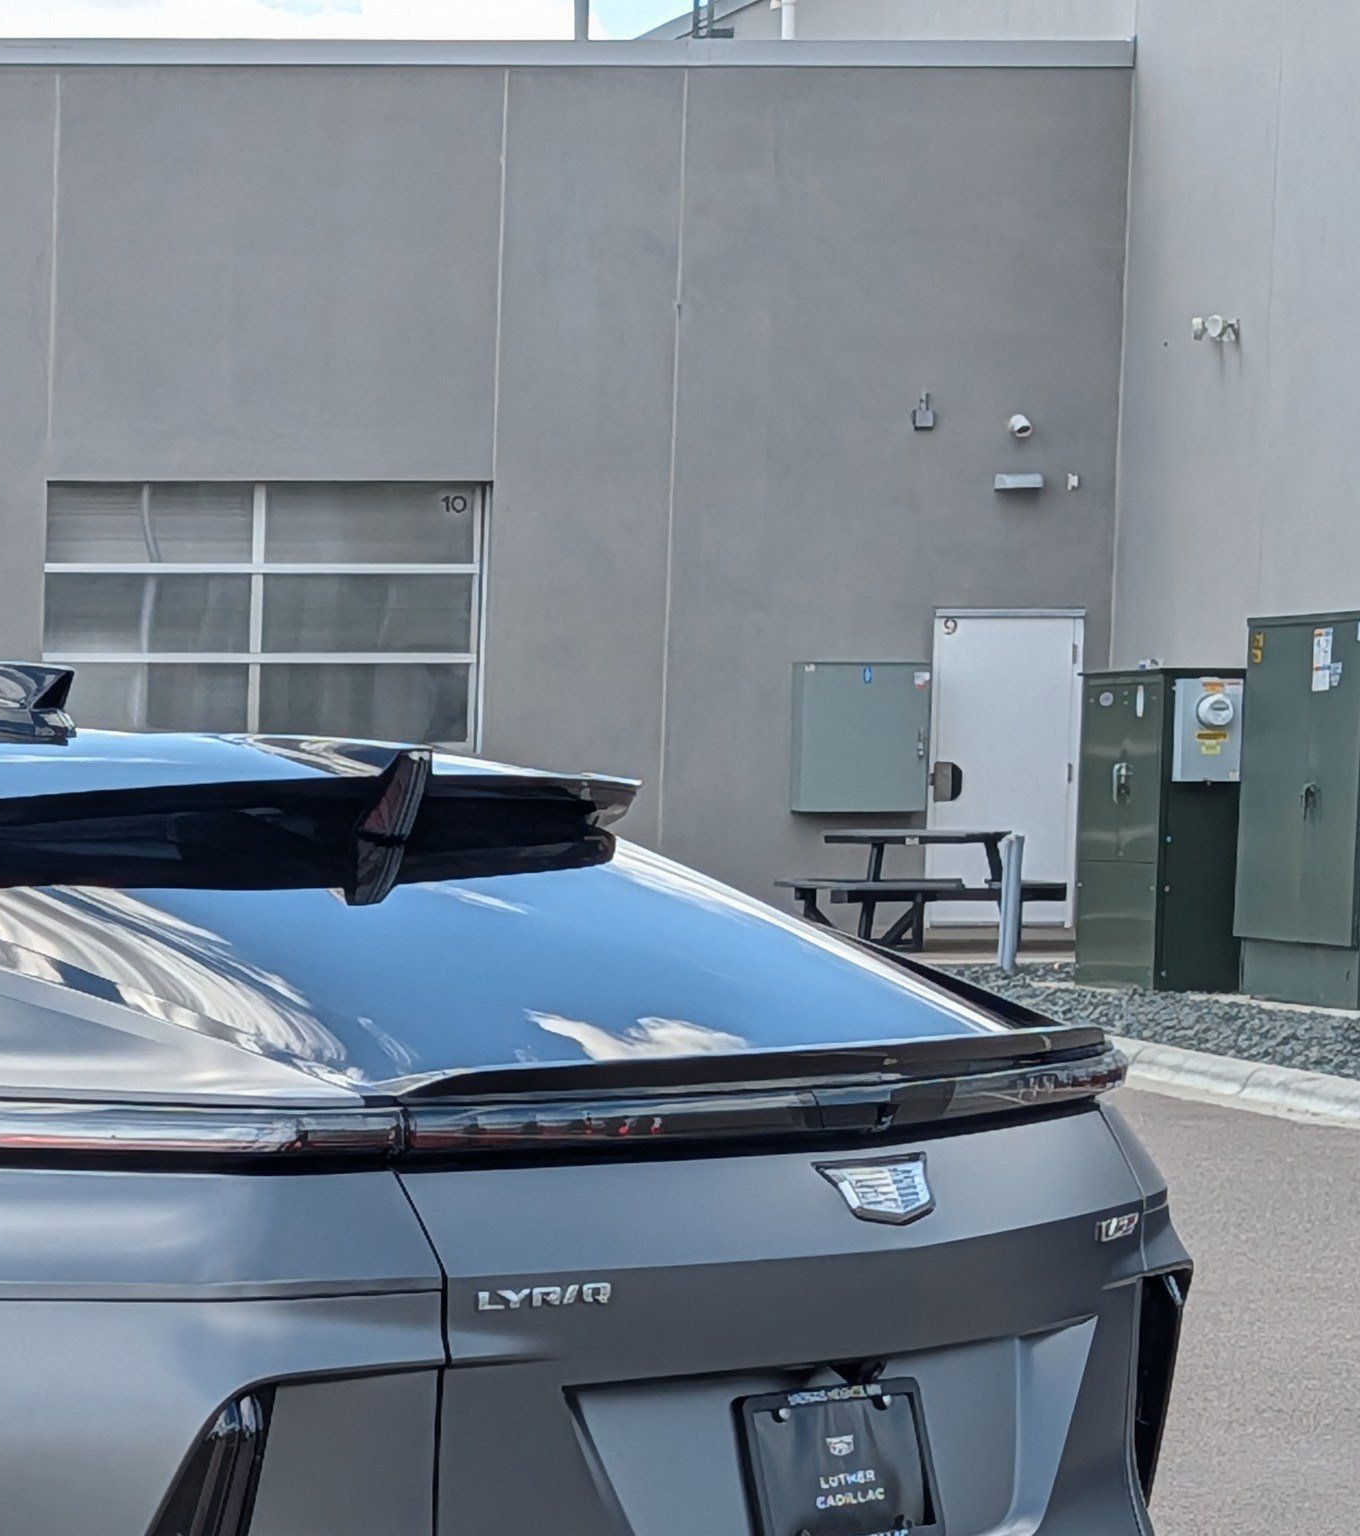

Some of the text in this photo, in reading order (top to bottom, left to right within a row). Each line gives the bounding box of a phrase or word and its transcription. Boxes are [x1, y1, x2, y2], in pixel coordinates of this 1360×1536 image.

[441, 495, 467, 514] 10
[943, 616, 958, 636] 9
[819, 1469, 876, 1490] LUTHER
[815, 1487, 886, 1510] CADILLAC
